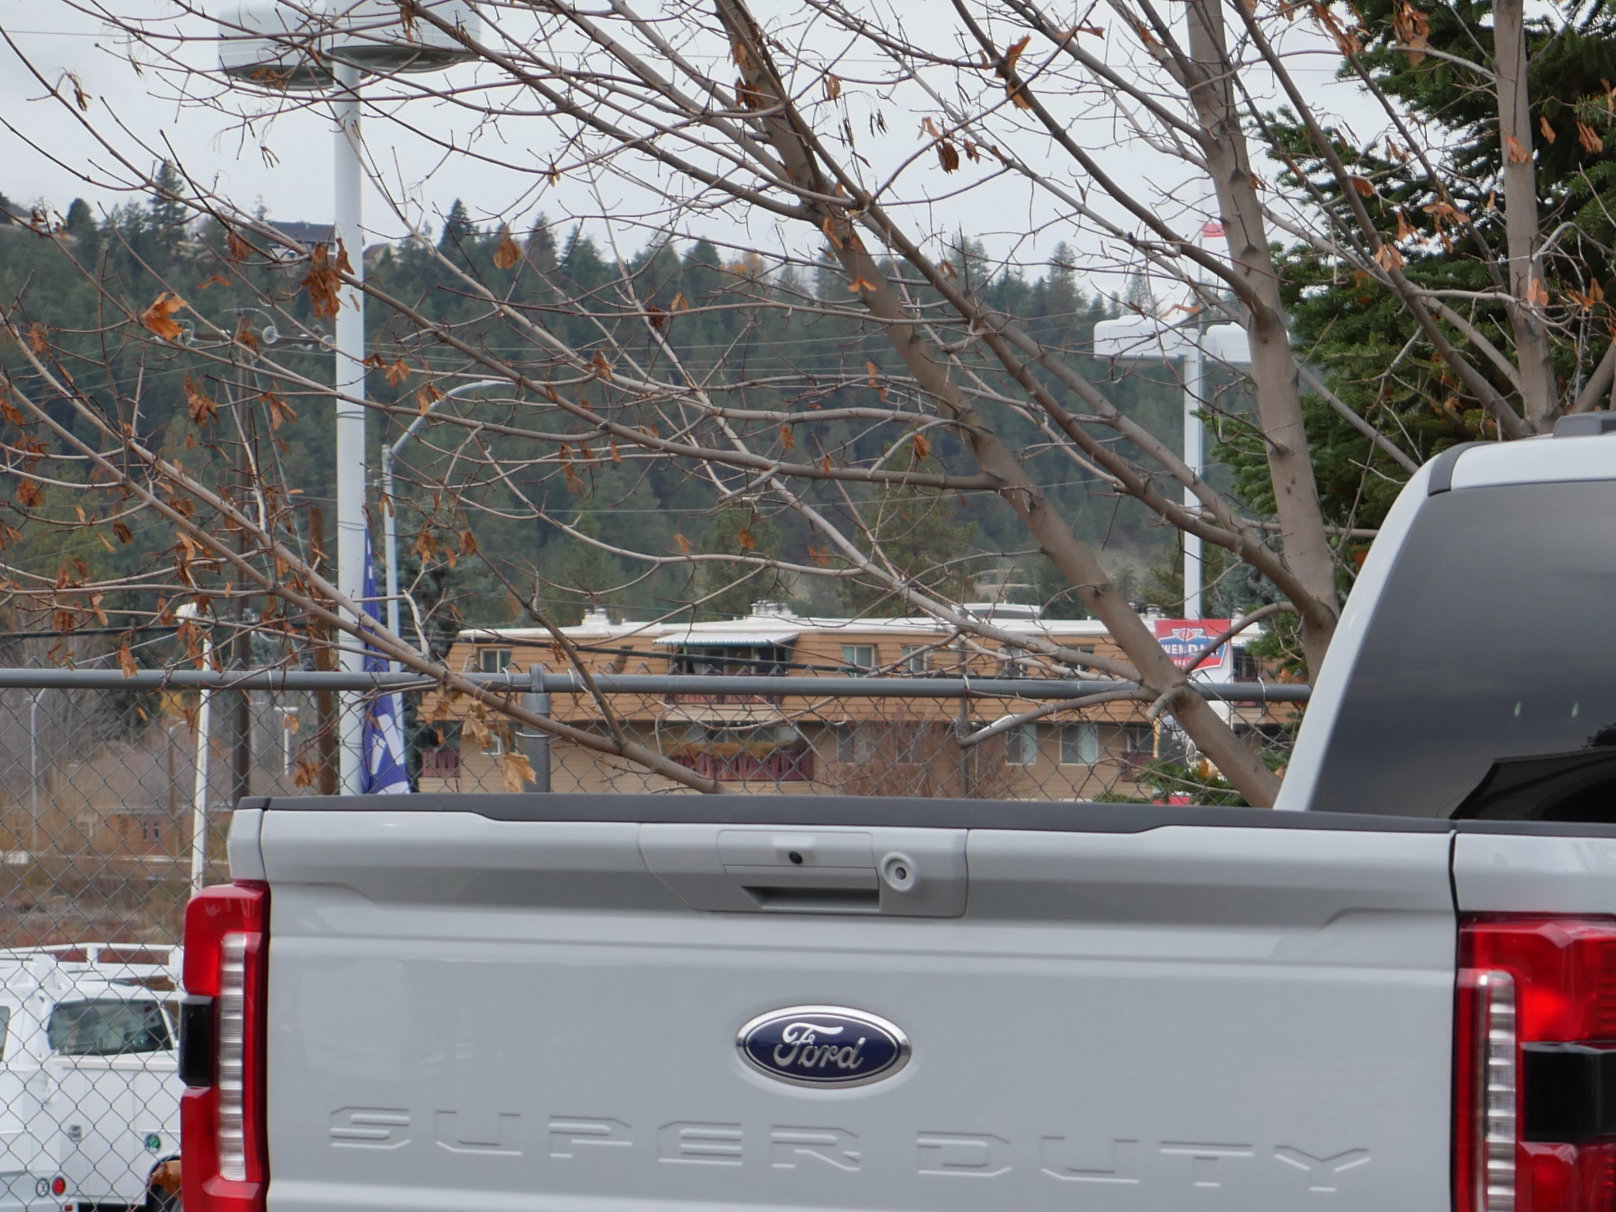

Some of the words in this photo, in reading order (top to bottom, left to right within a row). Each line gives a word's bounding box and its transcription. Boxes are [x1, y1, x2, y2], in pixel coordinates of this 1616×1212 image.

[773, 1022, 866, 1070] Ford
[329, 1106, 861, 1172] SUPER
[917, 1130, 1371, 1192] DUTY
